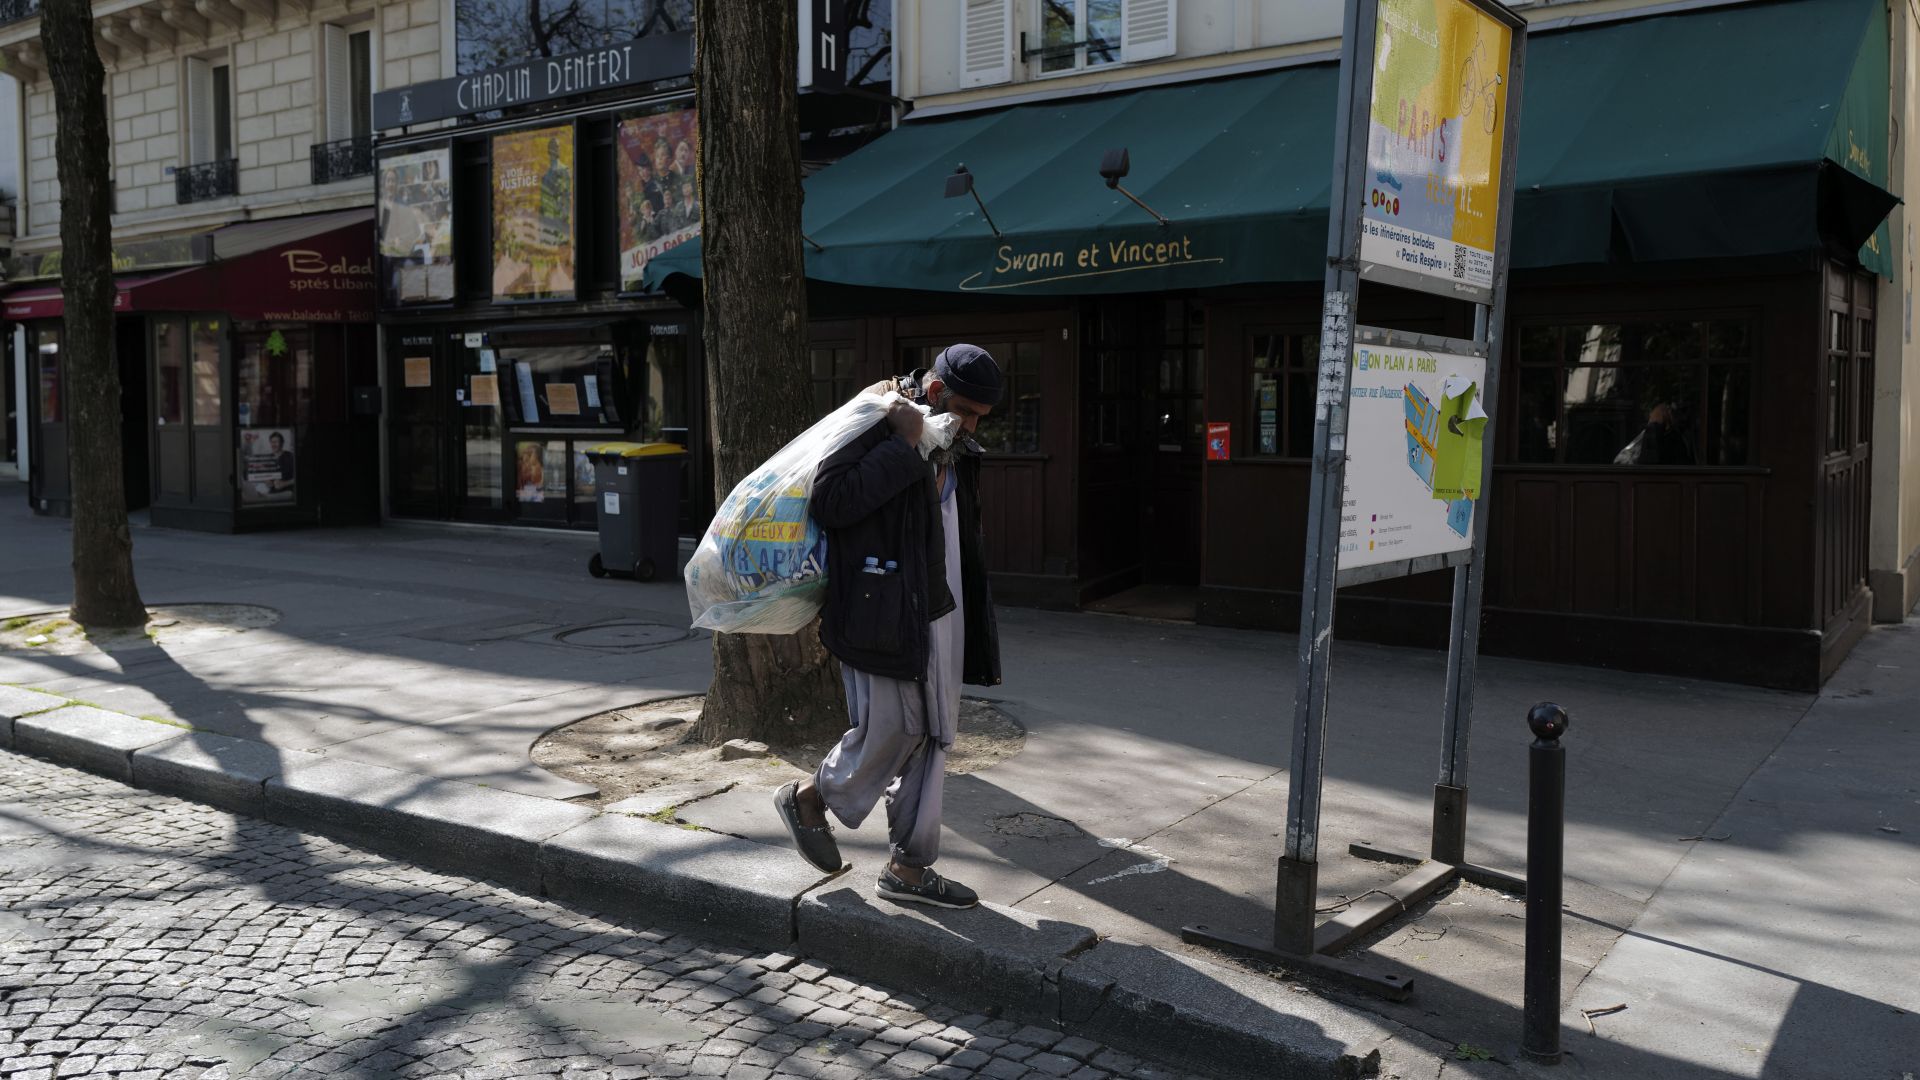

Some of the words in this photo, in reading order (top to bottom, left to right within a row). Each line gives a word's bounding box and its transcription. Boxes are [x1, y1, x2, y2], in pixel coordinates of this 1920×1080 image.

[457, 67, 531, 109] CHAPLIN
[548, 46, 632, 95] DENFERT
[1396, 98, 1447, 163] PARIS
[500, 175, 538, 191] JUSTICE
[1370, 221, 1378, 235] les
[1380, 224, 1411, 244] itinéraires
[1412, 233, 1435, 250] balades
[631, 246, 658, 268] JOJO
[995, 245, 1064, 273] Swann
[1077, 243, 1100, 268] et
[1109, 235, 1192, 263] Vincent
[1401, 248, 1418, 264] Paris
[1419, 252, 1442, 270] Respire
[289, 278, 330, 292] sptés
[263, 309, 341, 320] www.baladna.fr
[1384, 354, 1404, 371] PLAN
[1416, 358, 1437, 373] PARIS
[752, 523, 784, 539] DEUX
